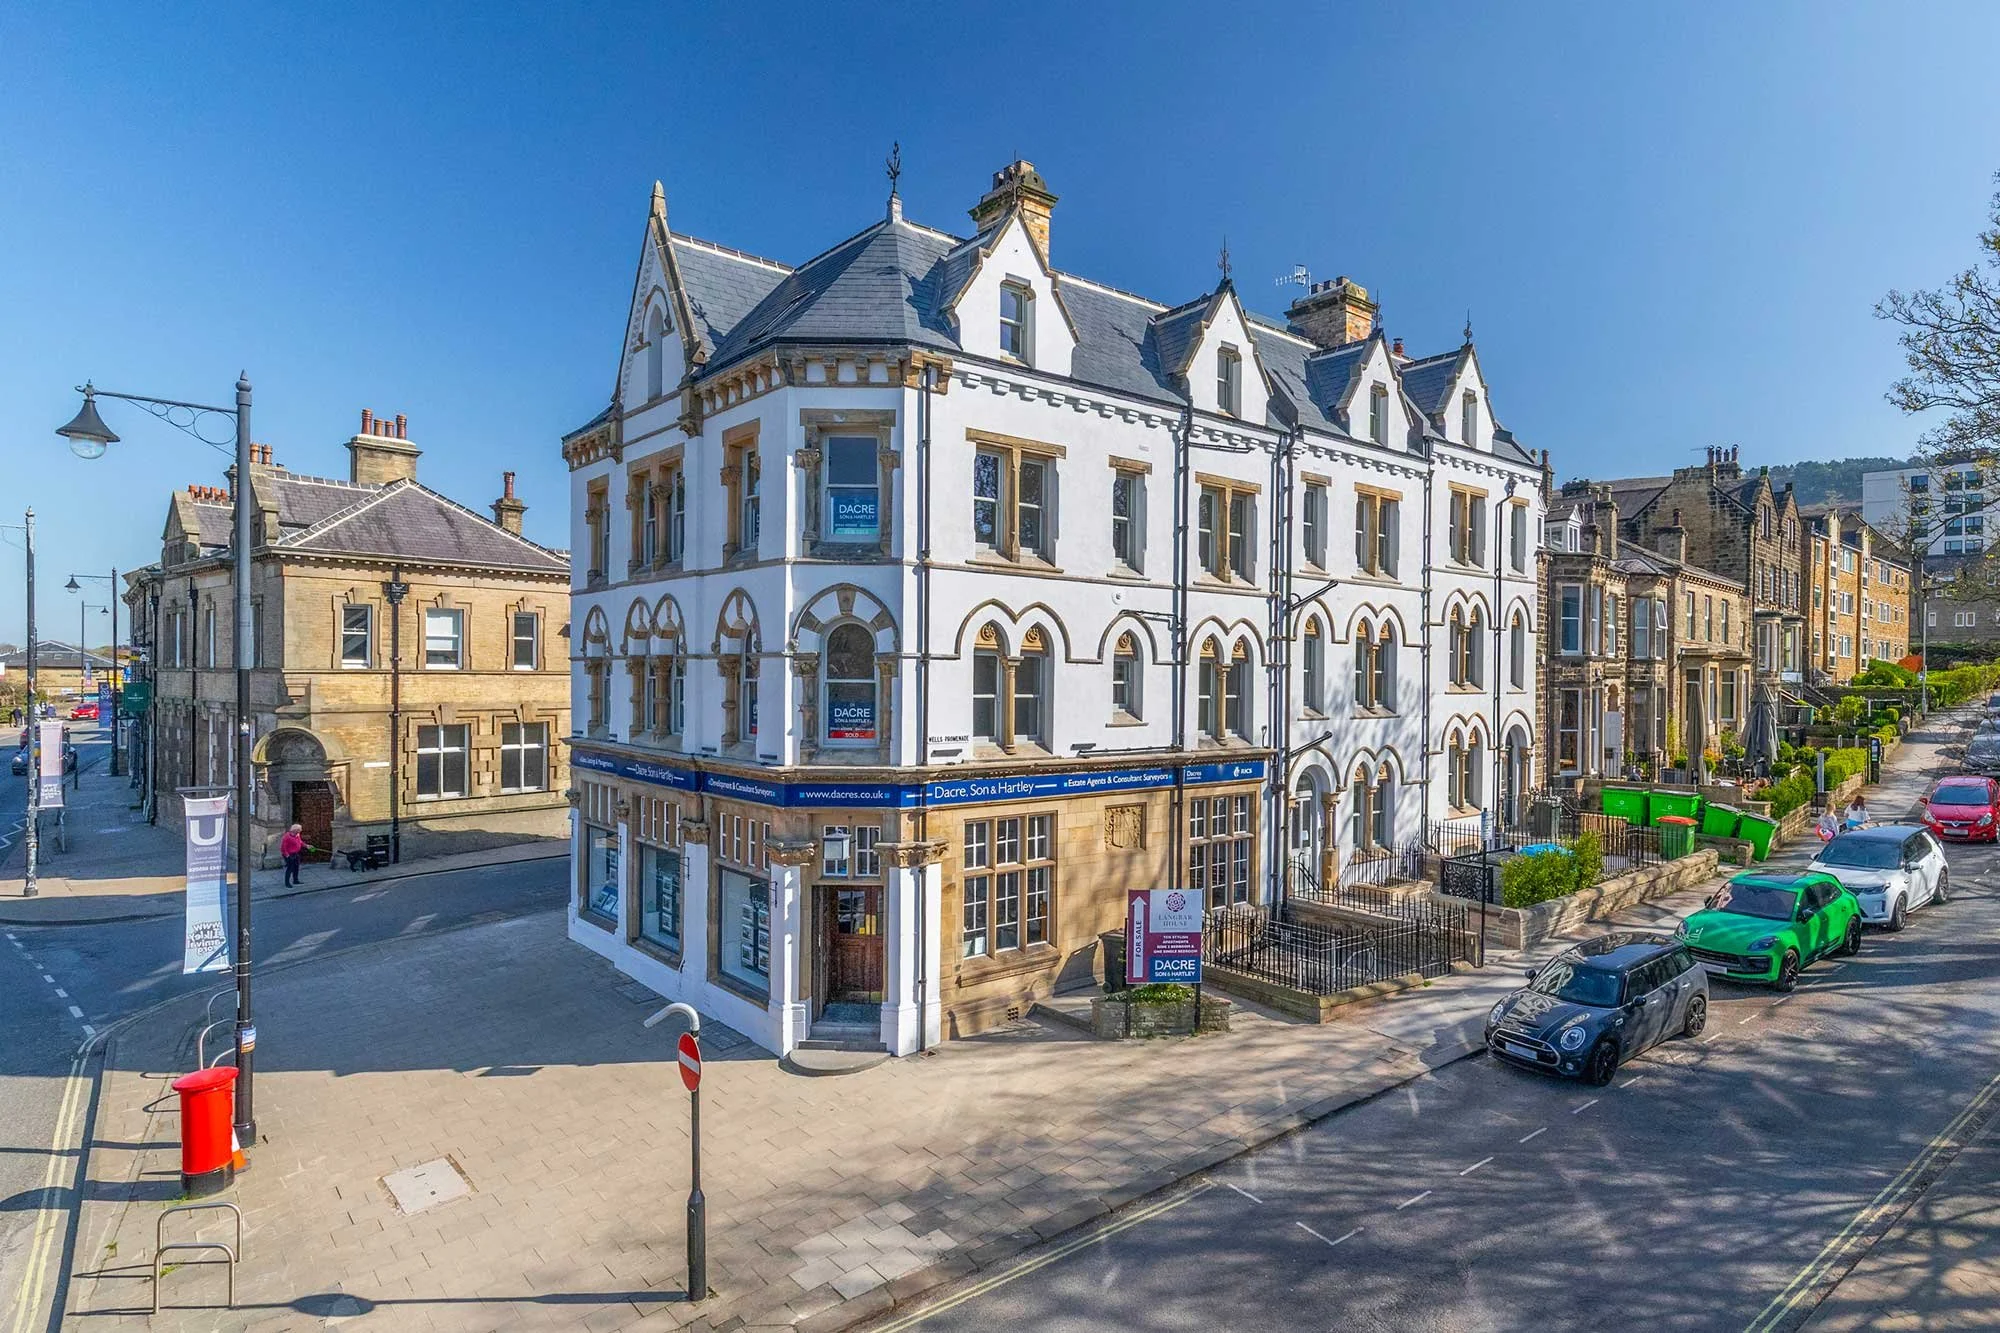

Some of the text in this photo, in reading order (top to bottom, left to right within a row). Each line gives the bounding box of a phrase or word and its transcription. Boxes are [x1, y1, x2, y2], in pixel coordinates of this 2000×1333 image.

[839, 504, 875, 514] DACRE
[834, 708, 871, 718] DACRE
[658, 767, 674, 784] Hartley
[1068, 773, 1169, 788] Estate Agents & Consultant Surveyors
[736, 782, 755, 793] Consultant
[755, 786, 773, 798] Surveyors
[806, 790, 884, 799] www.dacres.co.uk
[970, 783, 989, 796] Son
[990, 786, 997, 795] &
[998, 781, 1035, 795] Hartley
[1154, 959, 1196, 970] DACRE
